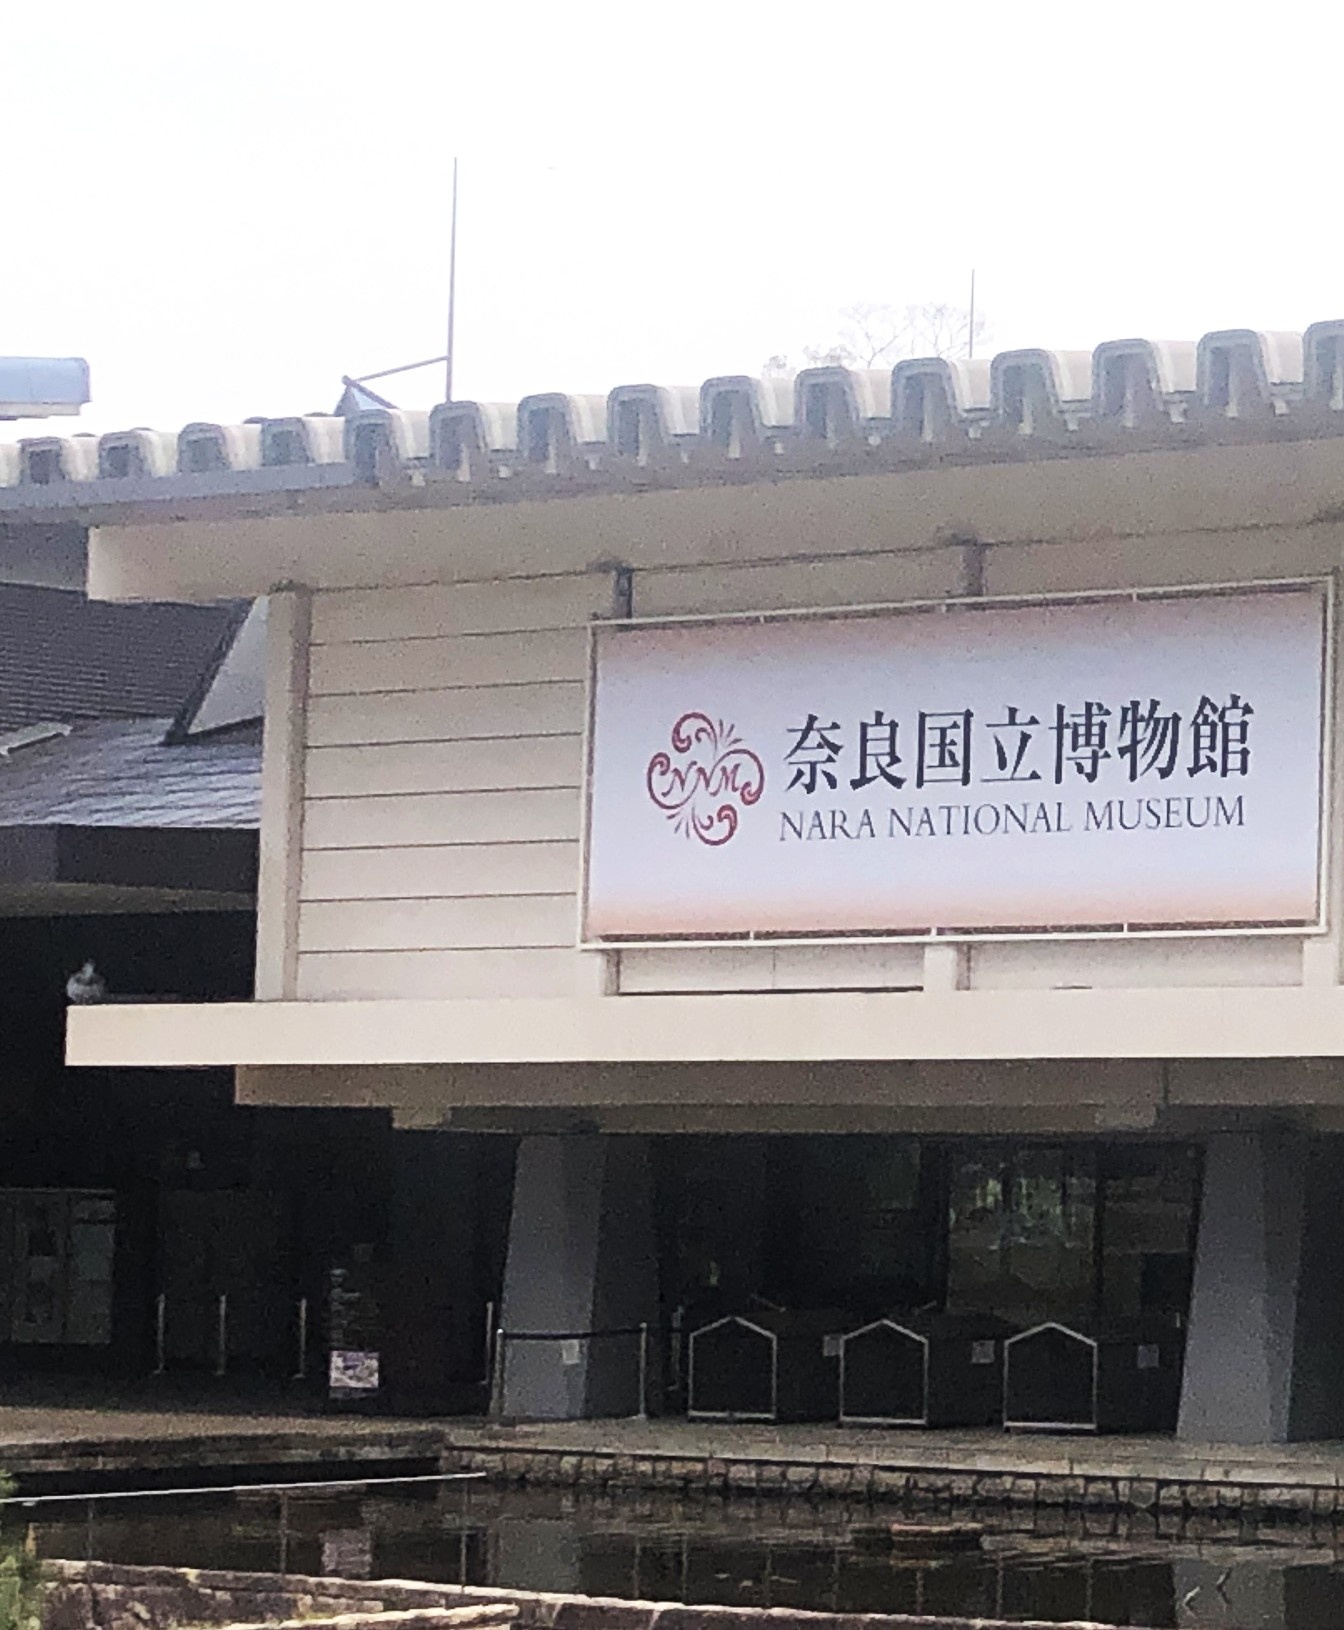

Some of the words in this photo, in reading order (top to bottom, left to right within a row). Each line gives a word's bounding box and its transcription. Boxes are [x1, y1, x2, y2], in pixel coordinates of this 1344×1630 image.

[783, 693, 1255, 795] 奈良国立博物館
[779, 808, 876, 842] NARA
[888, 801, 1073, 838] NATIONAL
[1084, 795, 1246, 833] MUSEUM
